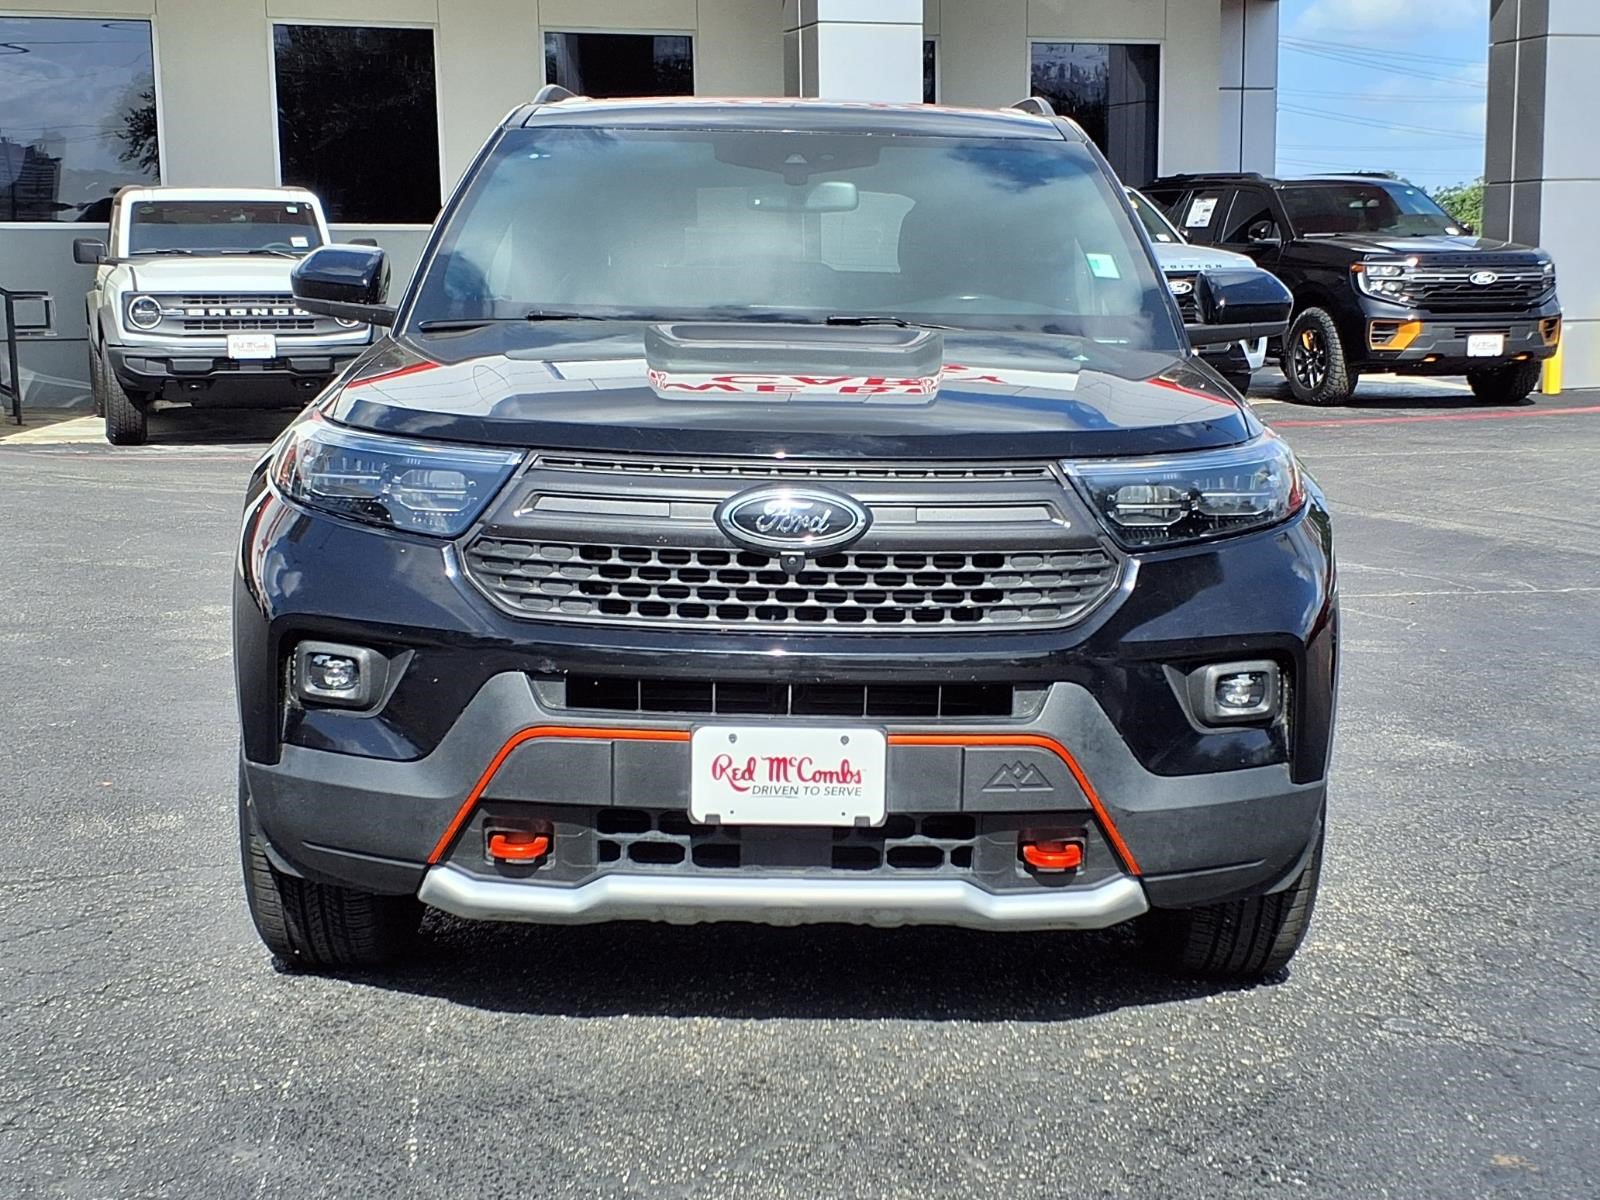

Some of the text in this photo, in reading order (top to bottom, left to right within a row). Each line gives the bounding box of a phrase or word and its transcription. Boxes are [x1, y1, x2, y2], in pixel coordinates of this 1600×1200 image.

[187, 308, 310, 316] BRONCO
[755, 500, 832, 534] Ford
[712, 754, 862, 792] Red McCombs
[752, 785, 862, 797] DRIVEN TO SERVE
